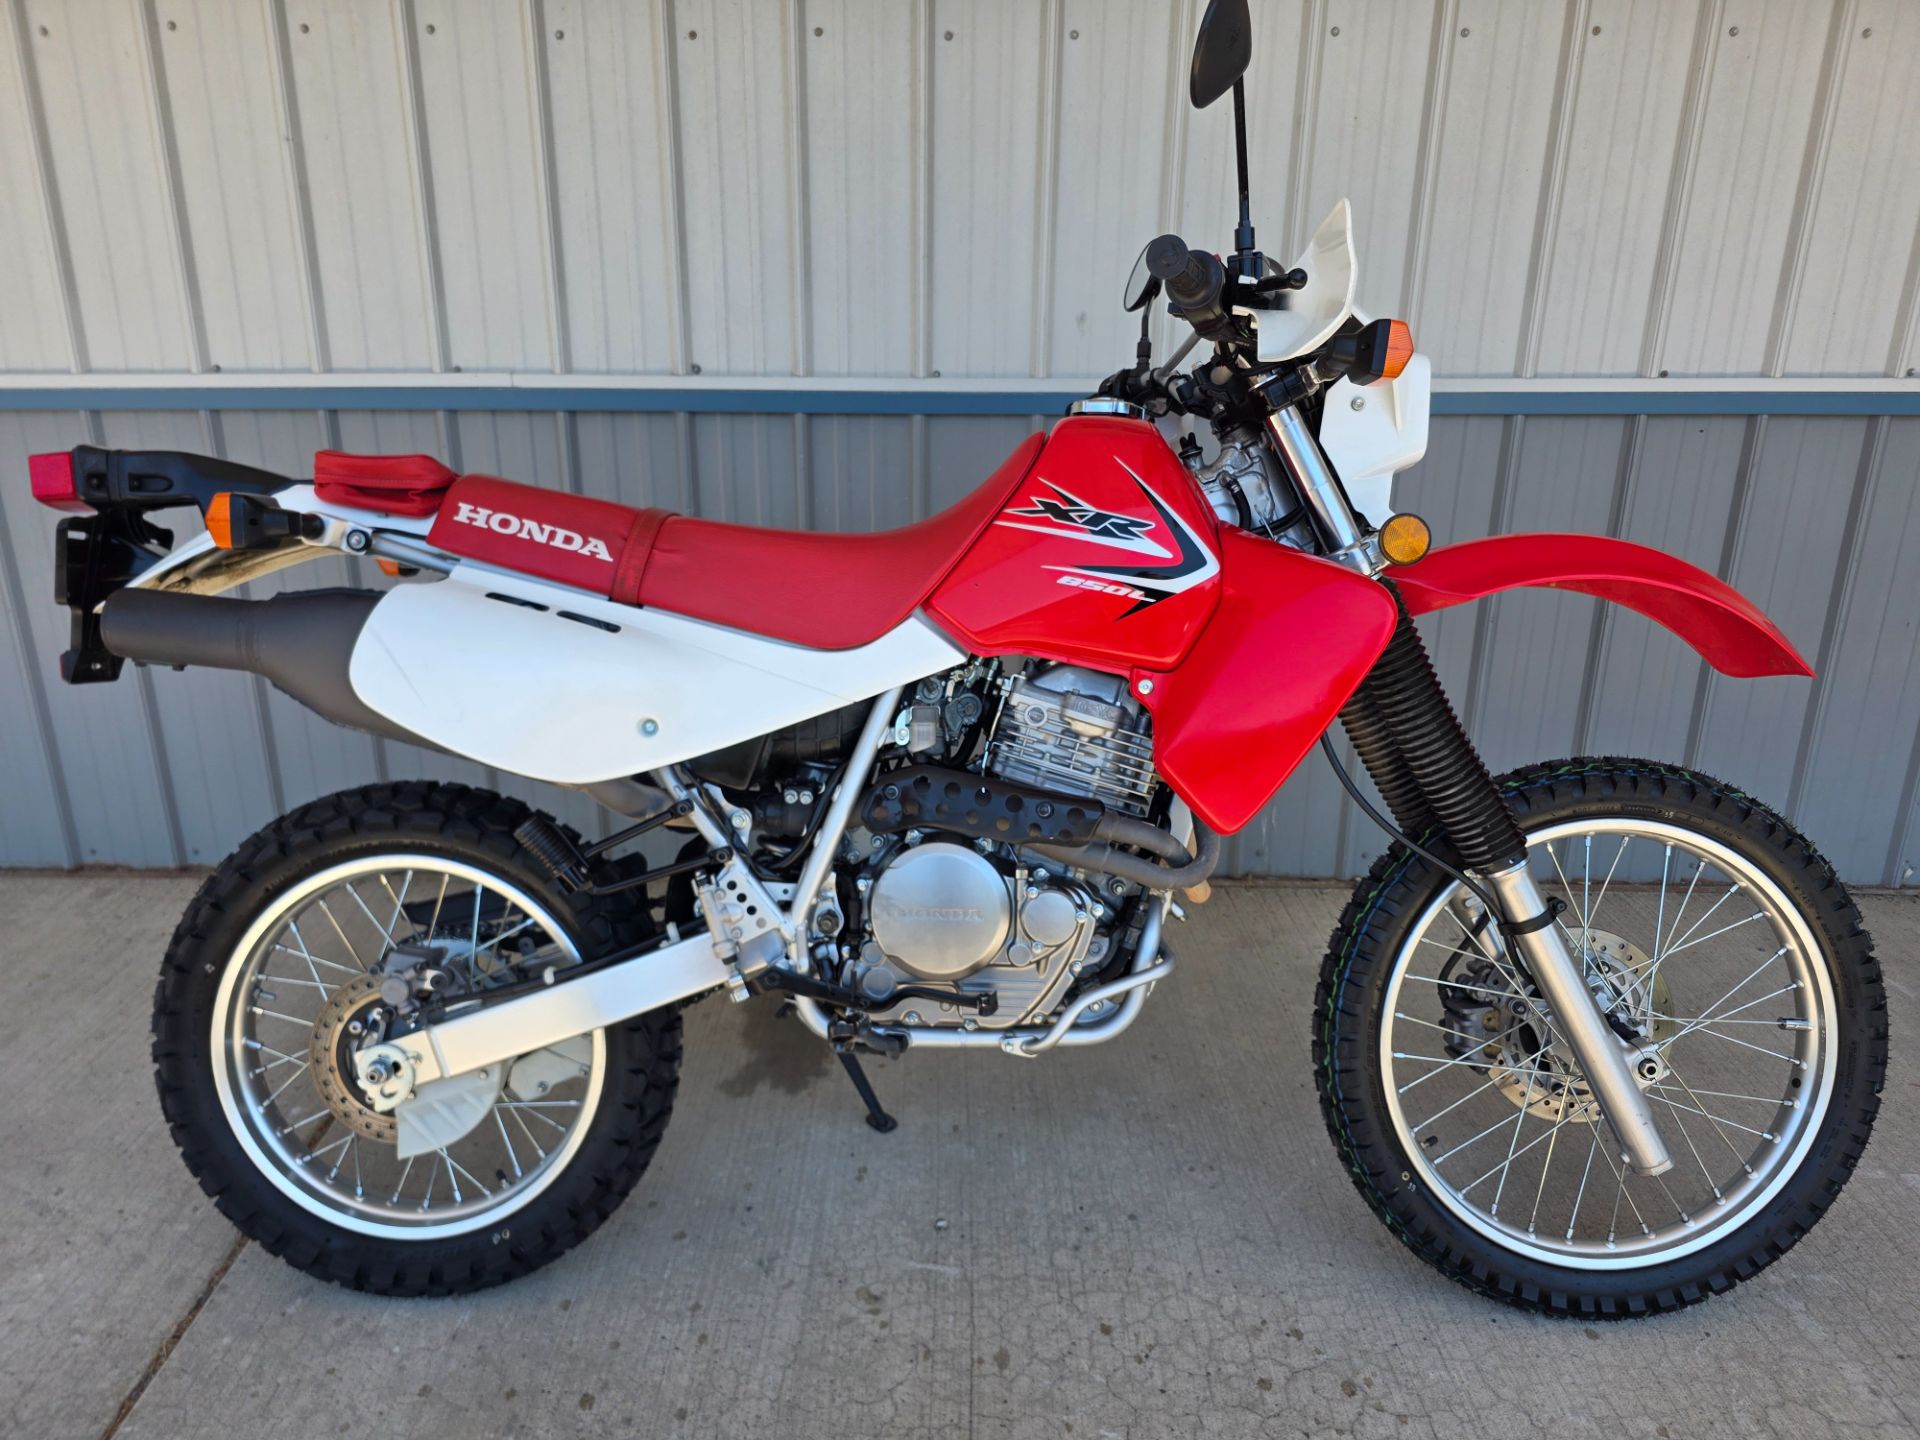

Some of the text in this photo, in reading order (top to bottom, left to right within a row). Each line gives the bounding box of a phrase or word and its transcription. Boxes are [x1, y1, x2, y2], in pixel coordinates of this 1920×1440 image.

[453, 502, 613, 562] HONDA
[1003, 497, 1155, 541] XR
[1056, 575, 1157, 603] 650L
